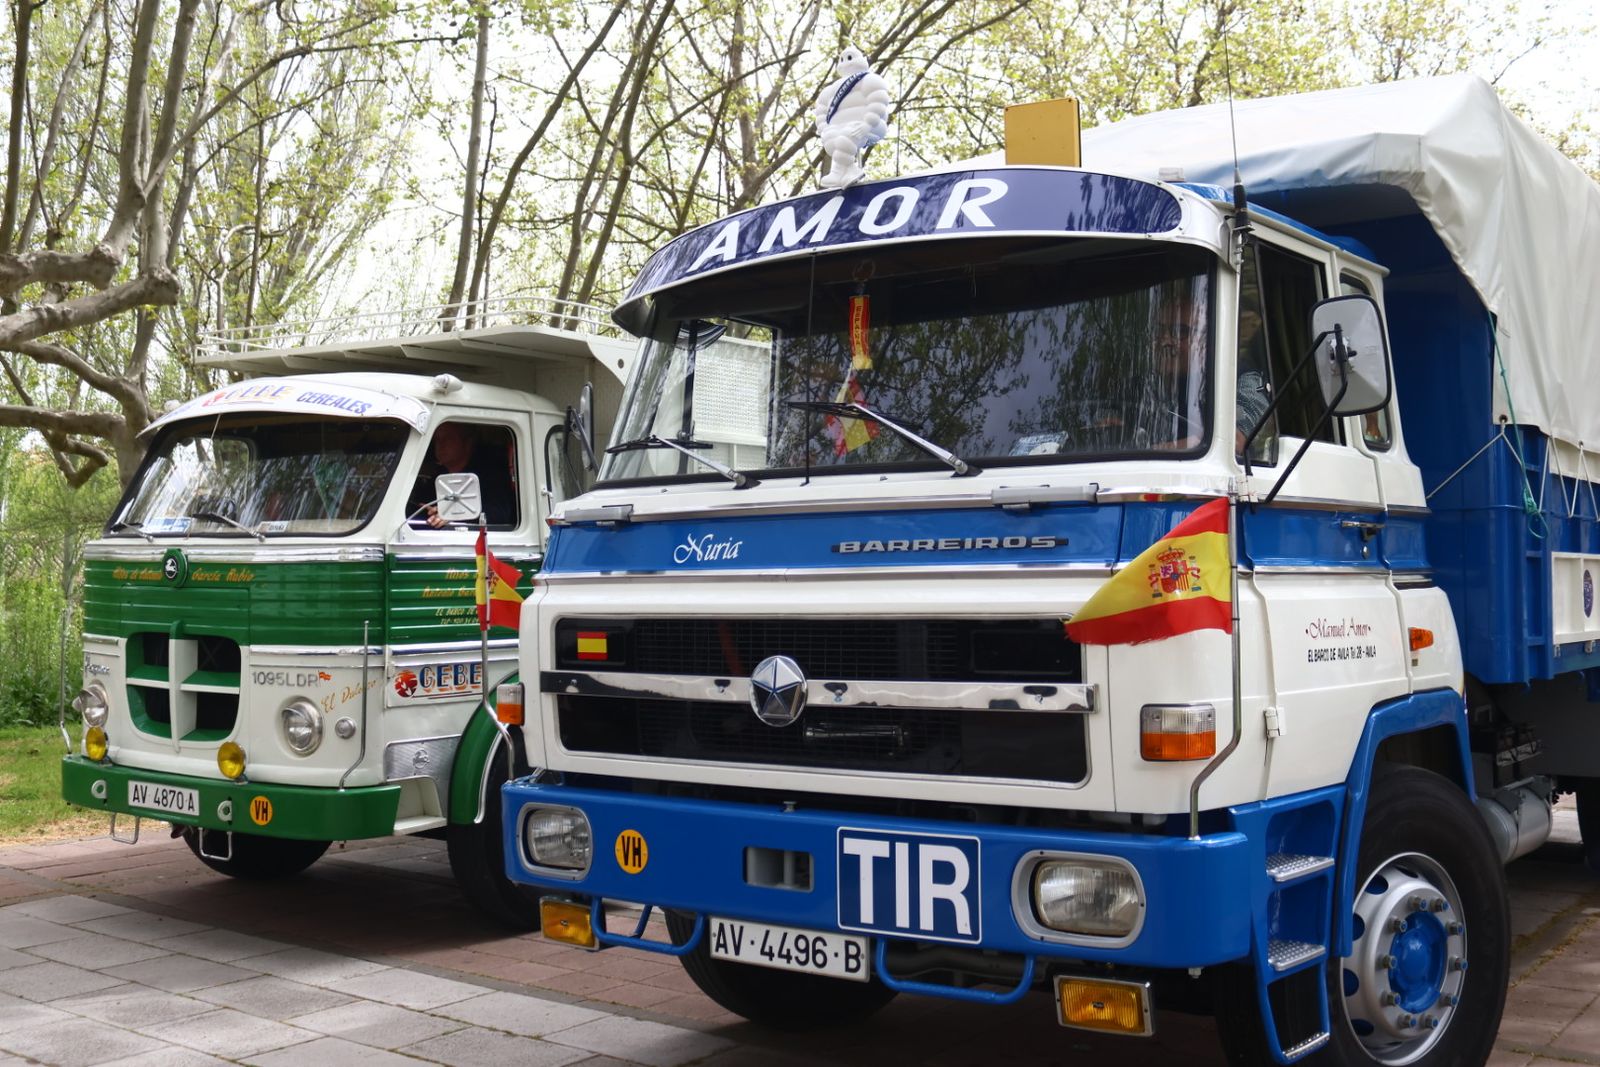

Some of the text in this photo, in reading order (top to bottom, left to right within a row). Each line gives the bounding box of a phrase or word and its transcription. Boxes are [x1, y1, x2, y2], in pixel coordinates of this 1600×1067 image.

[687, 177, 1010, 273] AMOR
[296, 391, 372, 414] CEREALES
[672, 532, 1057, 565] Nuria BARREIROS
[419, 663, 482, 690] GEBE
[255, 800, 268, 821] VH
[621, 834, 642, 868] VH
[843, 837, 972, 935] TIR
